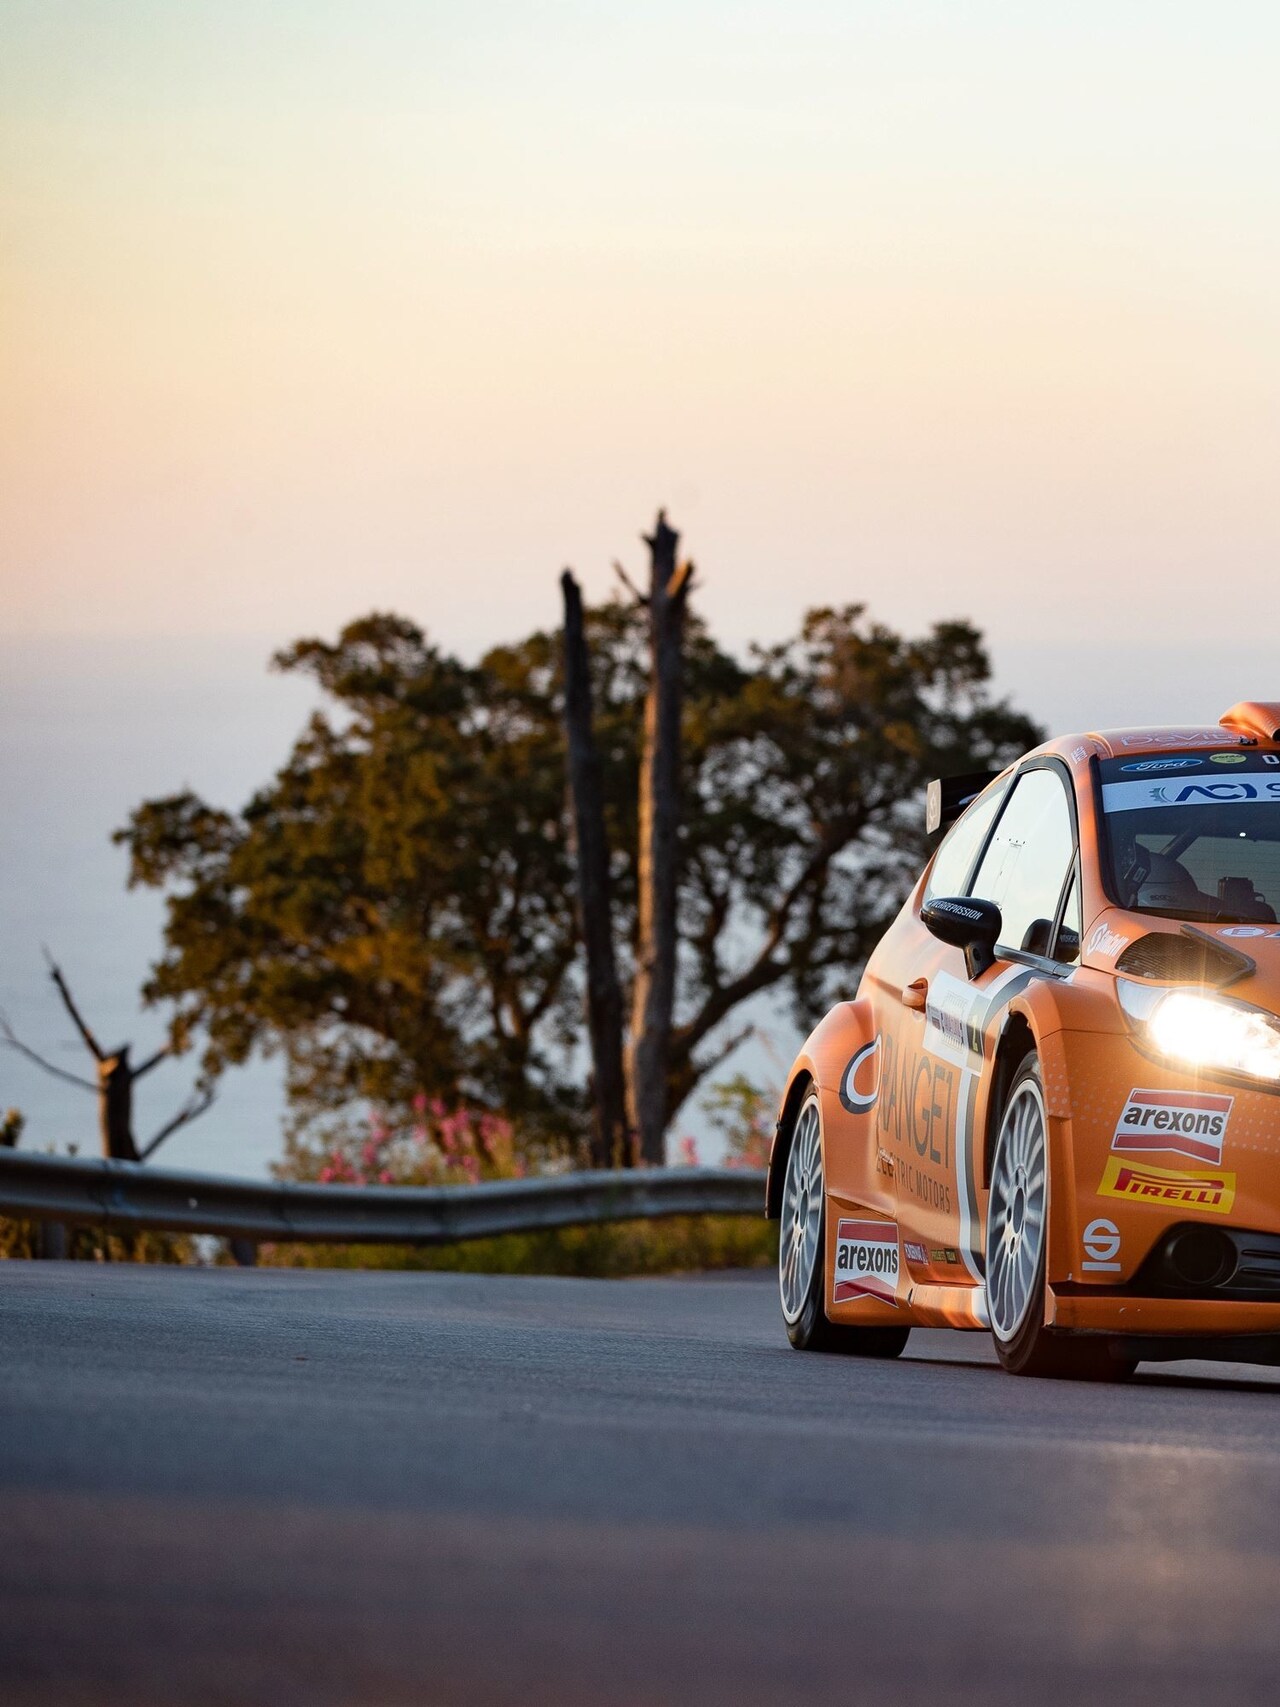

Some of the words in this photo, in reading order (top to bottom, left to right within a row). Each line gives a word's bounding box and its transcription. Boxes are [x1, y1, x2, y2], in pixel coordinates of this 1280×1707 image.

[1136, 759, 1190, 771] Ford
[1174, 783, 1257, 802] ACI
[1123, 1106, 1224, 1136] arexons
[916, 1169, 951, 1214] MOTORS
[1113, 1167, 1225, 1205] PIRELLI
[837, 1244, 898, 1274] arexons
